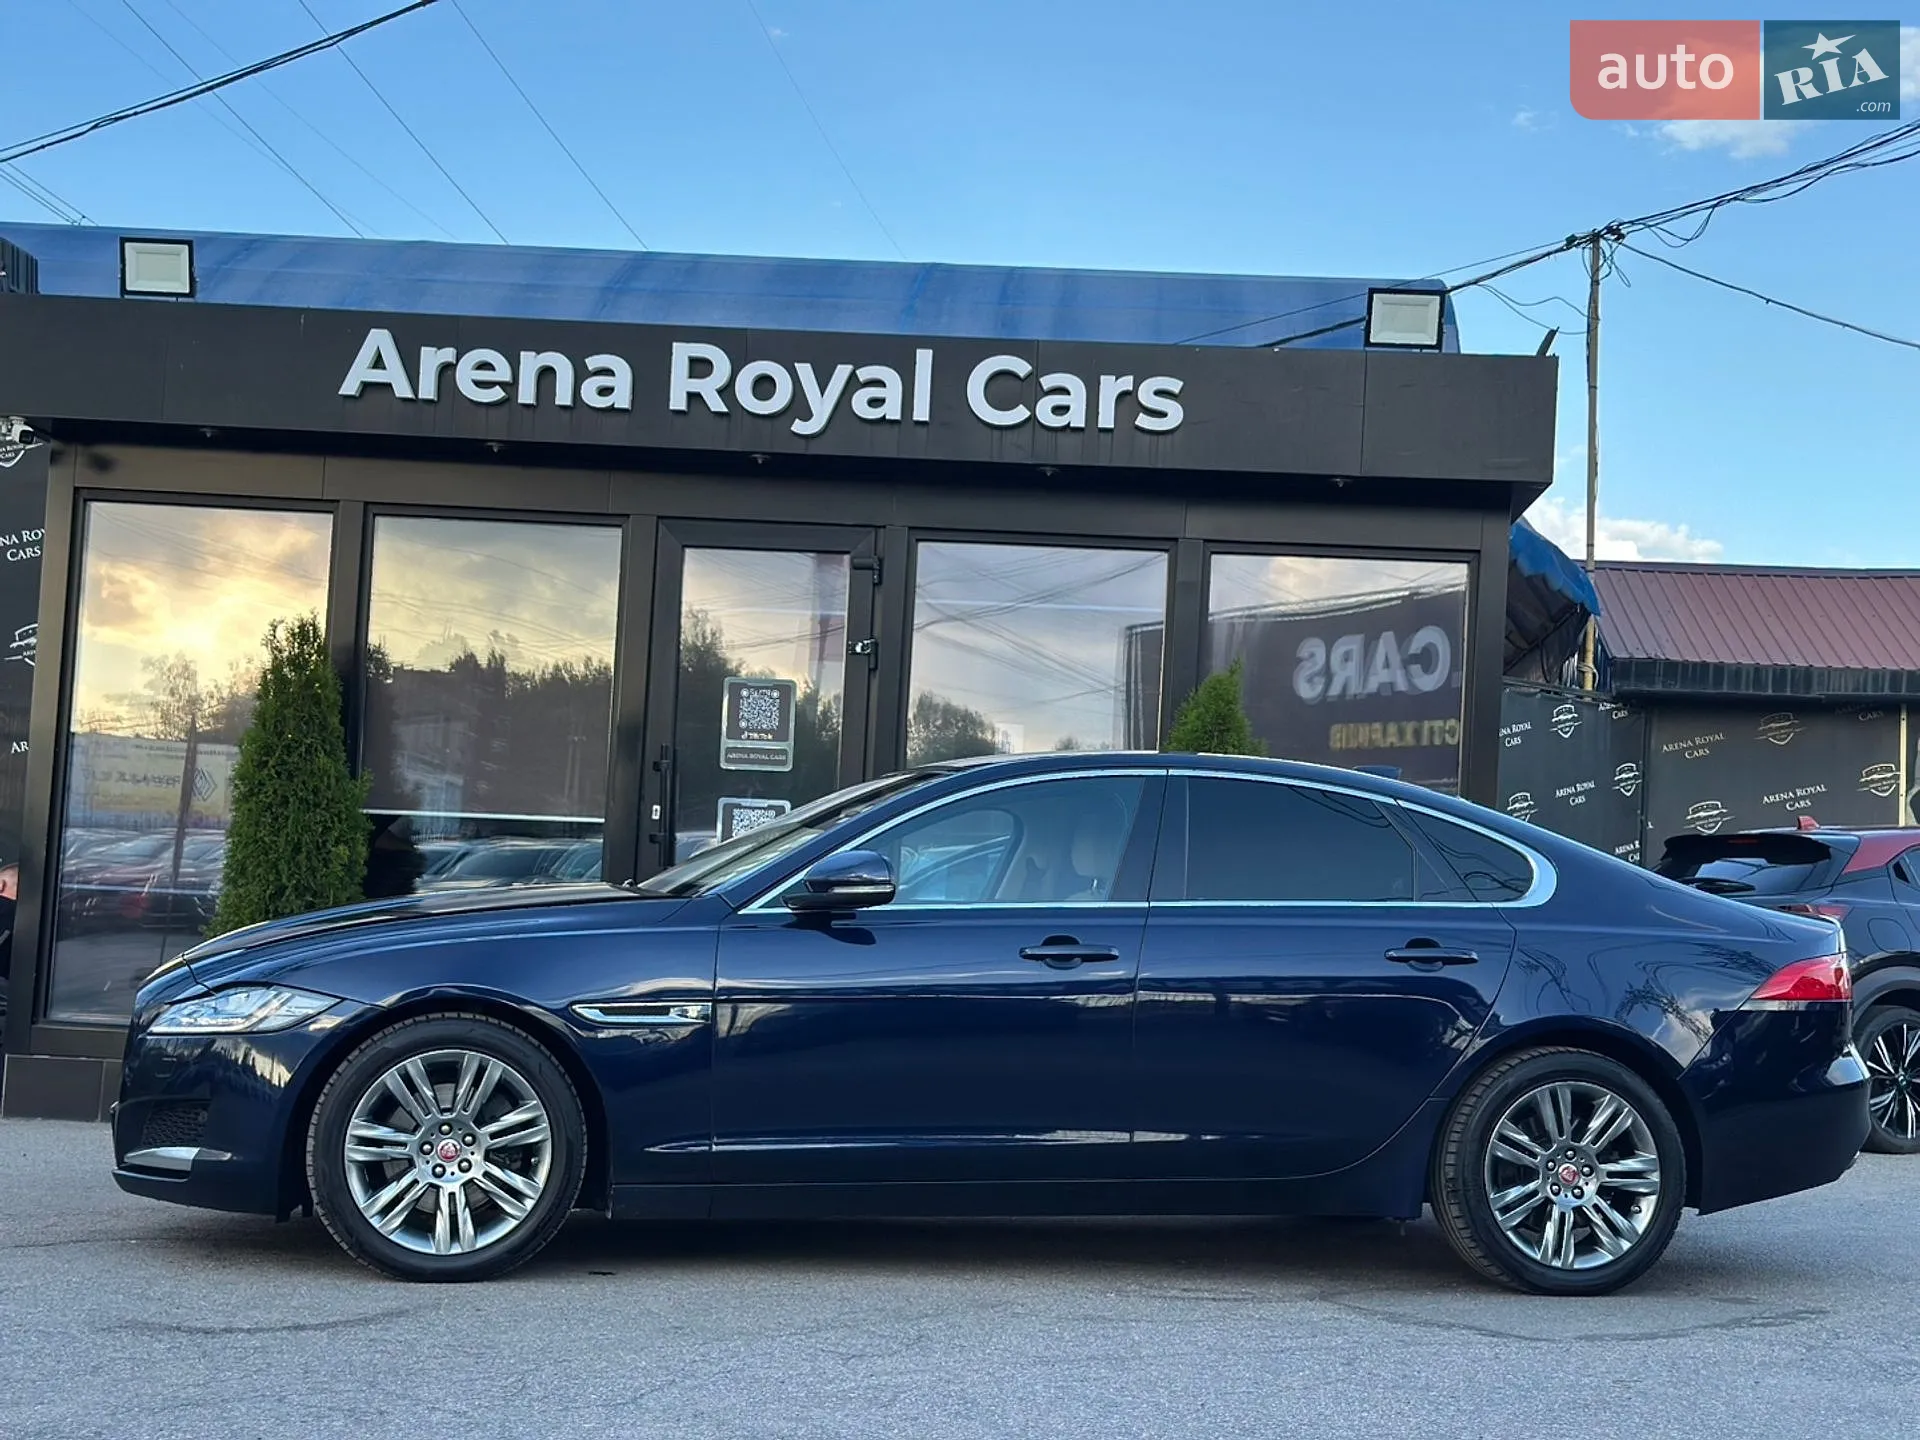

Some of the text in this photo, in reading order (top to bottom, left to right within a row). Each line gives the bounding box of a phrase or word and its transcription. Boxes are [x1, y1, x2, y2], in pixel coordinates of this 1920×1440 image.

[338, 328, 1185, 438] Arena Royal Cars
[7, 538, 41, 562] CARS
[11, 740, 29, 754] AR
[1662, 731, 1726, 753] ARENA ROYAL
[1684, 747, 1710, 759] CARS
[1762, 783, 1827, 805] ARENA ROYAL
[1785, 799, 1812, 811] CARS
